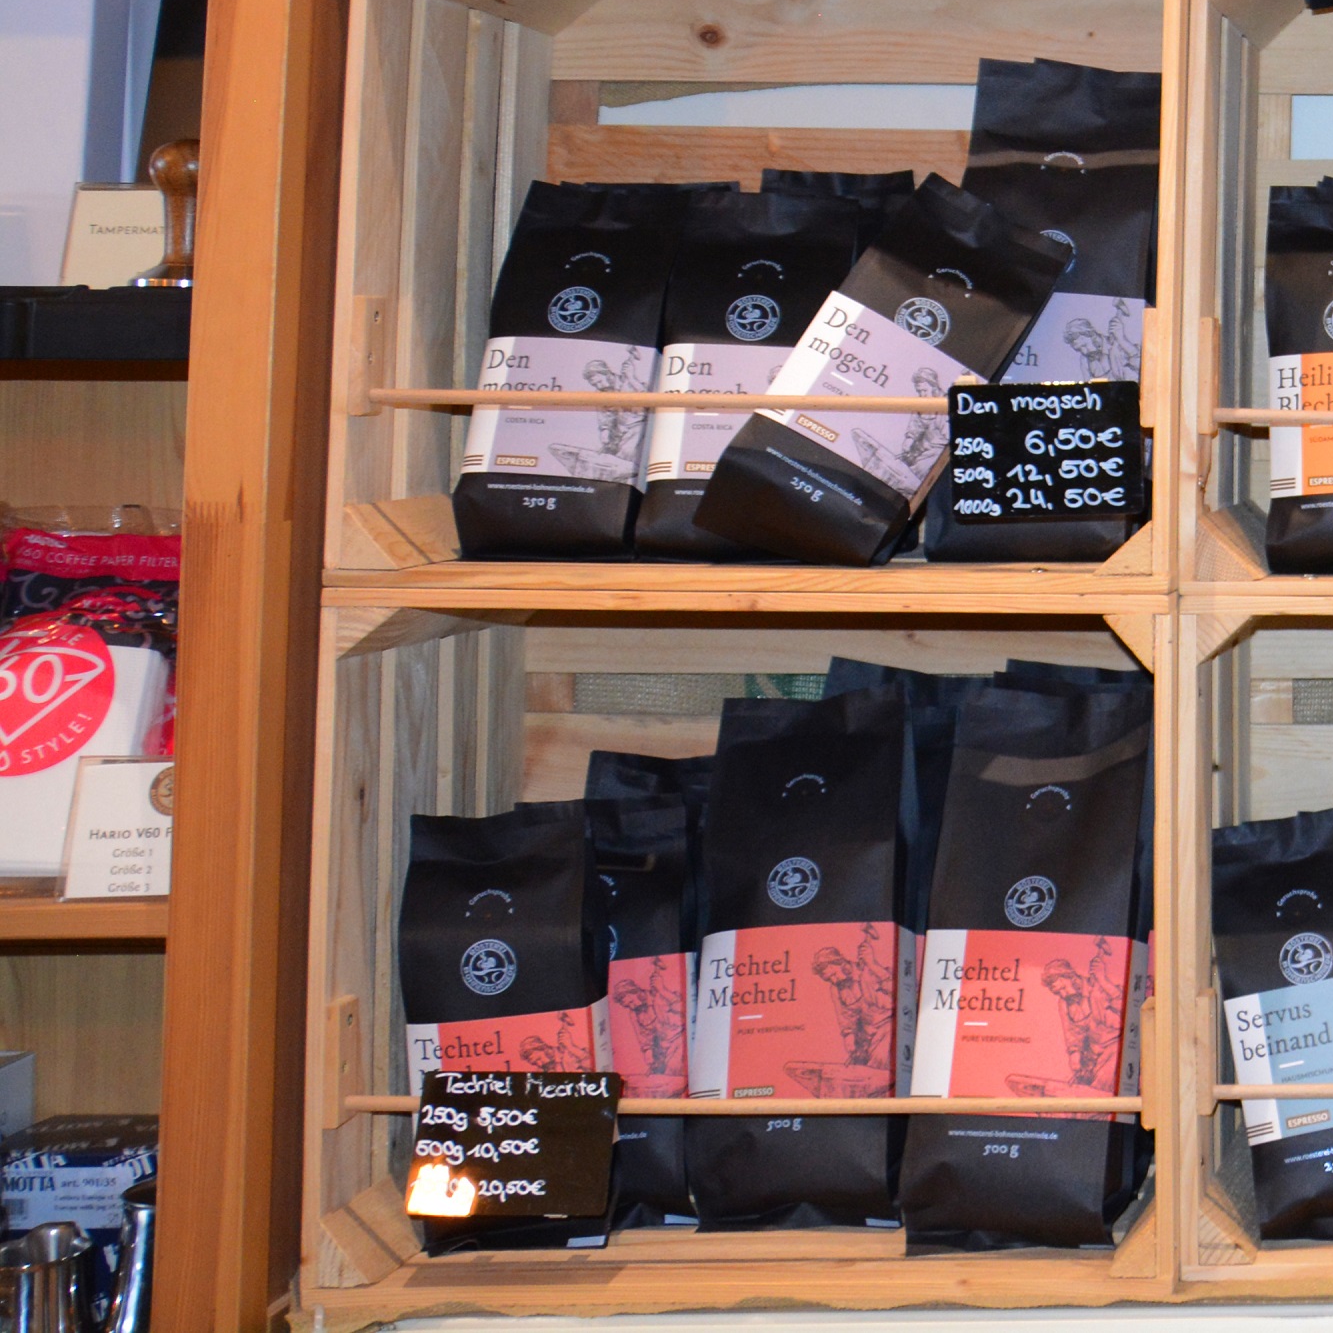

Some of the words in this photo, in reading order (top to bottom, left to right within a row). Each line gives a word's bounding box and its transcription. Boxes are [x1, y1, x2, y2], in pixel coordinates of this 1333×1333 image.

[824, 307, 871, 345] Den
[486, 349, 530, 369] Den
[666, 356, 713, 377] Den
[807, 337, 892, 389] mogsch
[957, 393, 998, 415] Den
[1011, 388, 1103, 419] mogsch
[954, 437, 995, 459] 250g
[1024, 426, 1123, 456] 6,50€
[496, 457, 536, 466] ESPRESSO
[46, 553, 97, 566] COFFEE
[139, 555, 178, 567] FILTER
[135, 827, 161, 839] V60
[112, 847, 145, 858] Größe
[110, 865, 142, 876] Größe
[146, 866, 152, 874] 2
[108, 882, 140, 894] Größe
[144, 883, 150, 893] 3
[711, 951, 792, 980] Techtel
[937, 958, 1021, 982] Techtel
[706, 981, 797, 1009] Mechtel
[932, 987, 1025, 1013] Mechtel
[1236, 1003, 1312, 1032] Servus
[414, 1031, 504, 1061] Techtel
[1239, 1025, 1332, 1062] beinand
[435, 1071, 514, 1097] Techtel
[3, 1176, 55, 1192] MOTTA
